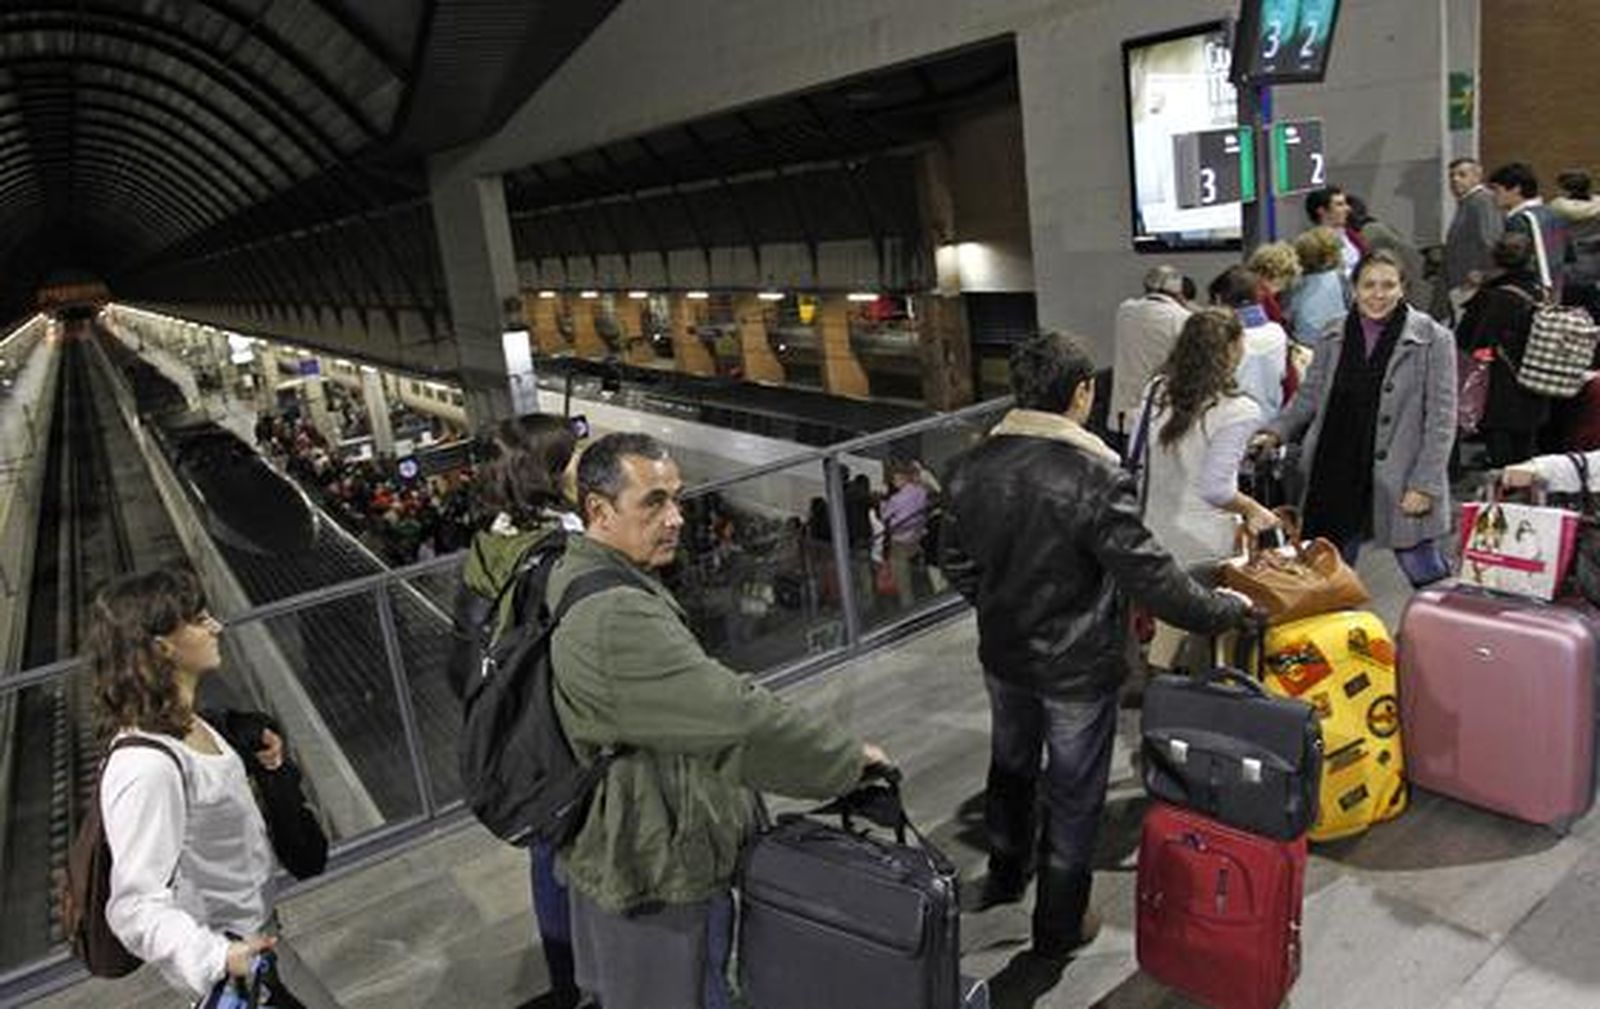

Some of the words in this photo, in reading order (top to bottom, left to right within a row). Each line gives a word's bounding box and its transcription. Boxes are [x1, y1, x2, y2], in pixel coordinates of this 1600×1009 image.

[1262, 20, 1281, 58] 3
[1300, 20, 1318, 56] 2
[1200, 167, 1217, 203] 3
[1309, 152, 1325, 185] 2
